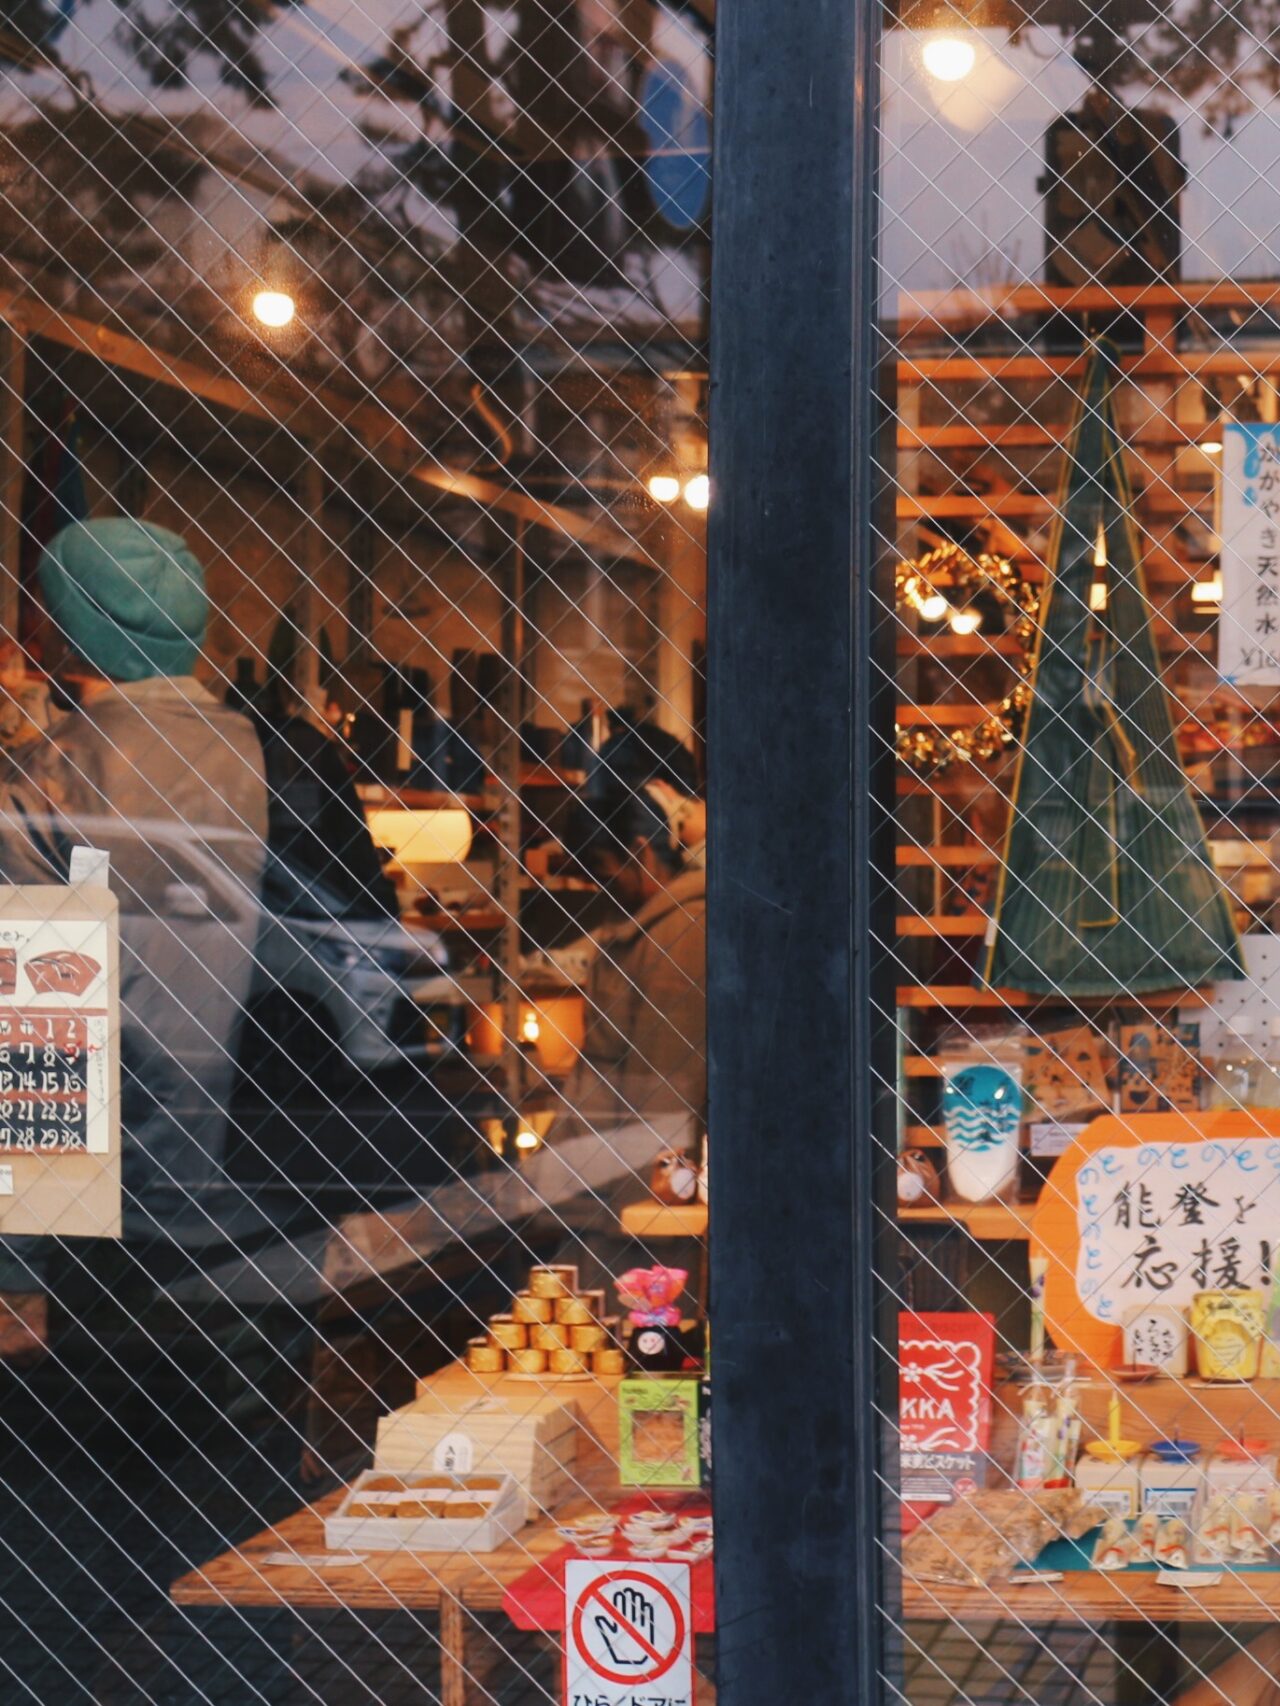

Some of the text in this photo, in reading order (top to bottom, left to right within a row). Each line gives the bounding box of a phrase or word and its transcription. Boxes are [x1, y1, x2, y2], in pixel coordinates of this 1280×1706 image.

[1113, 1180, 1256, 1229] 能登を
[1120, 1234, 1272, 1291] 応援!
